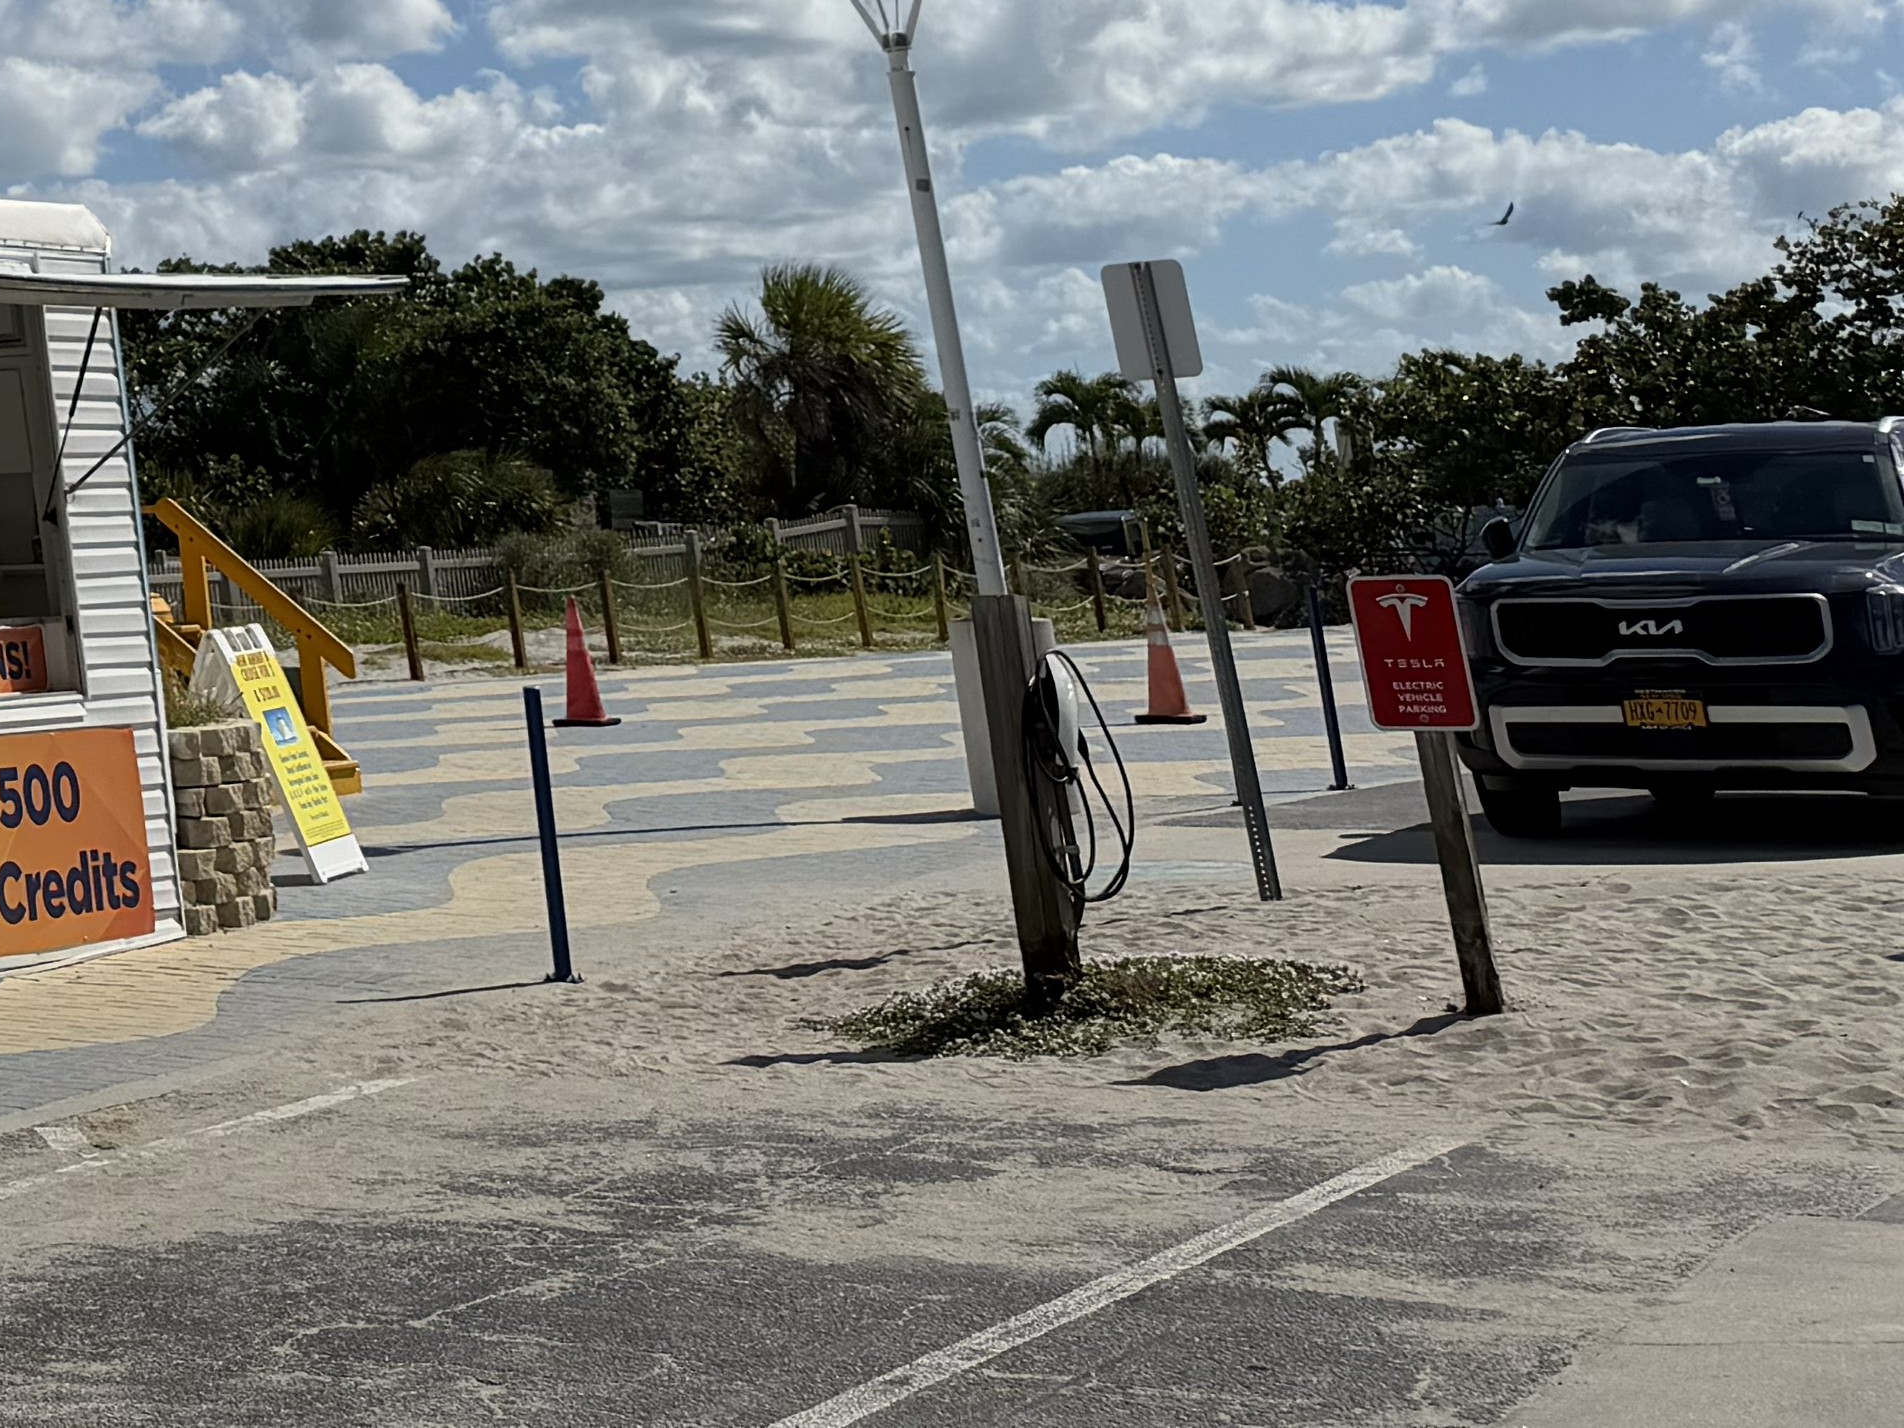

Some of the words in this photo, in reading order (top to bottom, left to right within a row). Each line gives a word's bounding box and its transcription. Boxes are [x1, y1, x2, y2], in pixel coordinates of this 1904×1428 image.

[1383, 658, 1446, 669] TESLA
[1392, 681, 1444, 691] ELECTRIC
[1397, 693, 1444, 703] VEHICLE
[1398, 704, 1448, 714] PARKING
